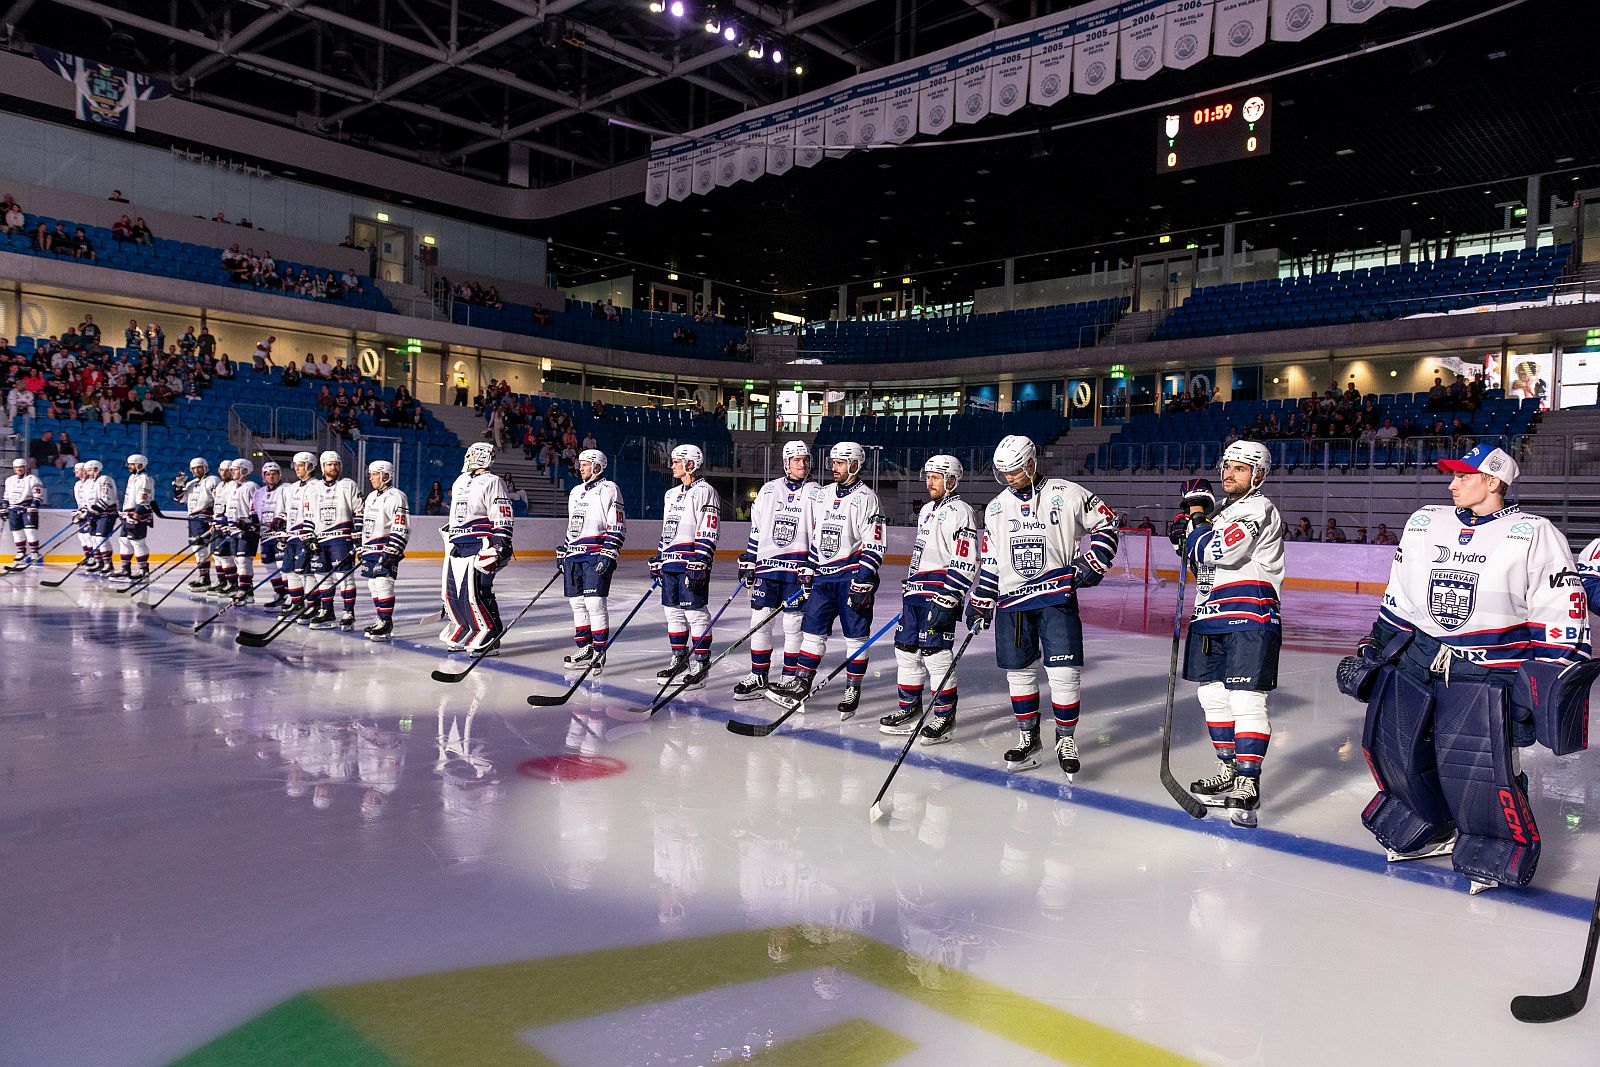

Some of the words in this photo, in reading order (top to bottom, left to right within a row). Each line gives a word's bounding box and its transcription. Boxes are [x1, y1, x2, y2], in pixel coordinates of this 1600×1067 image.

[1177, 0, 1202, 12] 2006
[1132, 12, 1156, 27] 2006
[1085, 28, 1109, 42] 2005
[1042, 42, 1064, 55] 2005
[1001, 53, 1022, 65] 2005
[929, 76, 947, 88] 2003
[894, 87, 912, 98] 2003
[861, 96, 878, 106] 2001
[833, 104, 849, 115] 2000
[1193, 103, 1234, 125] 01:59
[803, 114, 819, 125] 1999
[1248, 123, 1255, 131] T
[1247, 136, 1257, 152] 0
[1167, 152, 1177, 167] 0
[304, 501, 310, 511] 4
[499, 506, 512, 518] 45
[784, 505, 802, 513] Hydro
[394, 514, 407, 526] 26
[706, 514, 718, 530] 13
[830, 513, 847, 521] Hydro
[1049, 510, 1060, 526] C
[1022, 521, 1046, 531] Hydro
[874, 524, 881, 541] 5
[1223, 522, 1246, 547] 18
[1505, 534, 1530, 542] ARCONIC
[600, 548, 618, 559] CCM
[955, 539, 970, 557] 16
[981, 557, 998, 566] RTA
[1452, 551, 1487, 564] Hydro
[762, 558, 798, 570] TIPPMIX
[949, 559, 976, 573] BARTA
[1439, 616, 1459, 626] AV19
[1049, 654, 1074, 662] CCM
[1226, 676, 1252, 684] CCM
[1498, 789, 1527, 844] CCM
[1517, 790, 1540, 841] CCM
